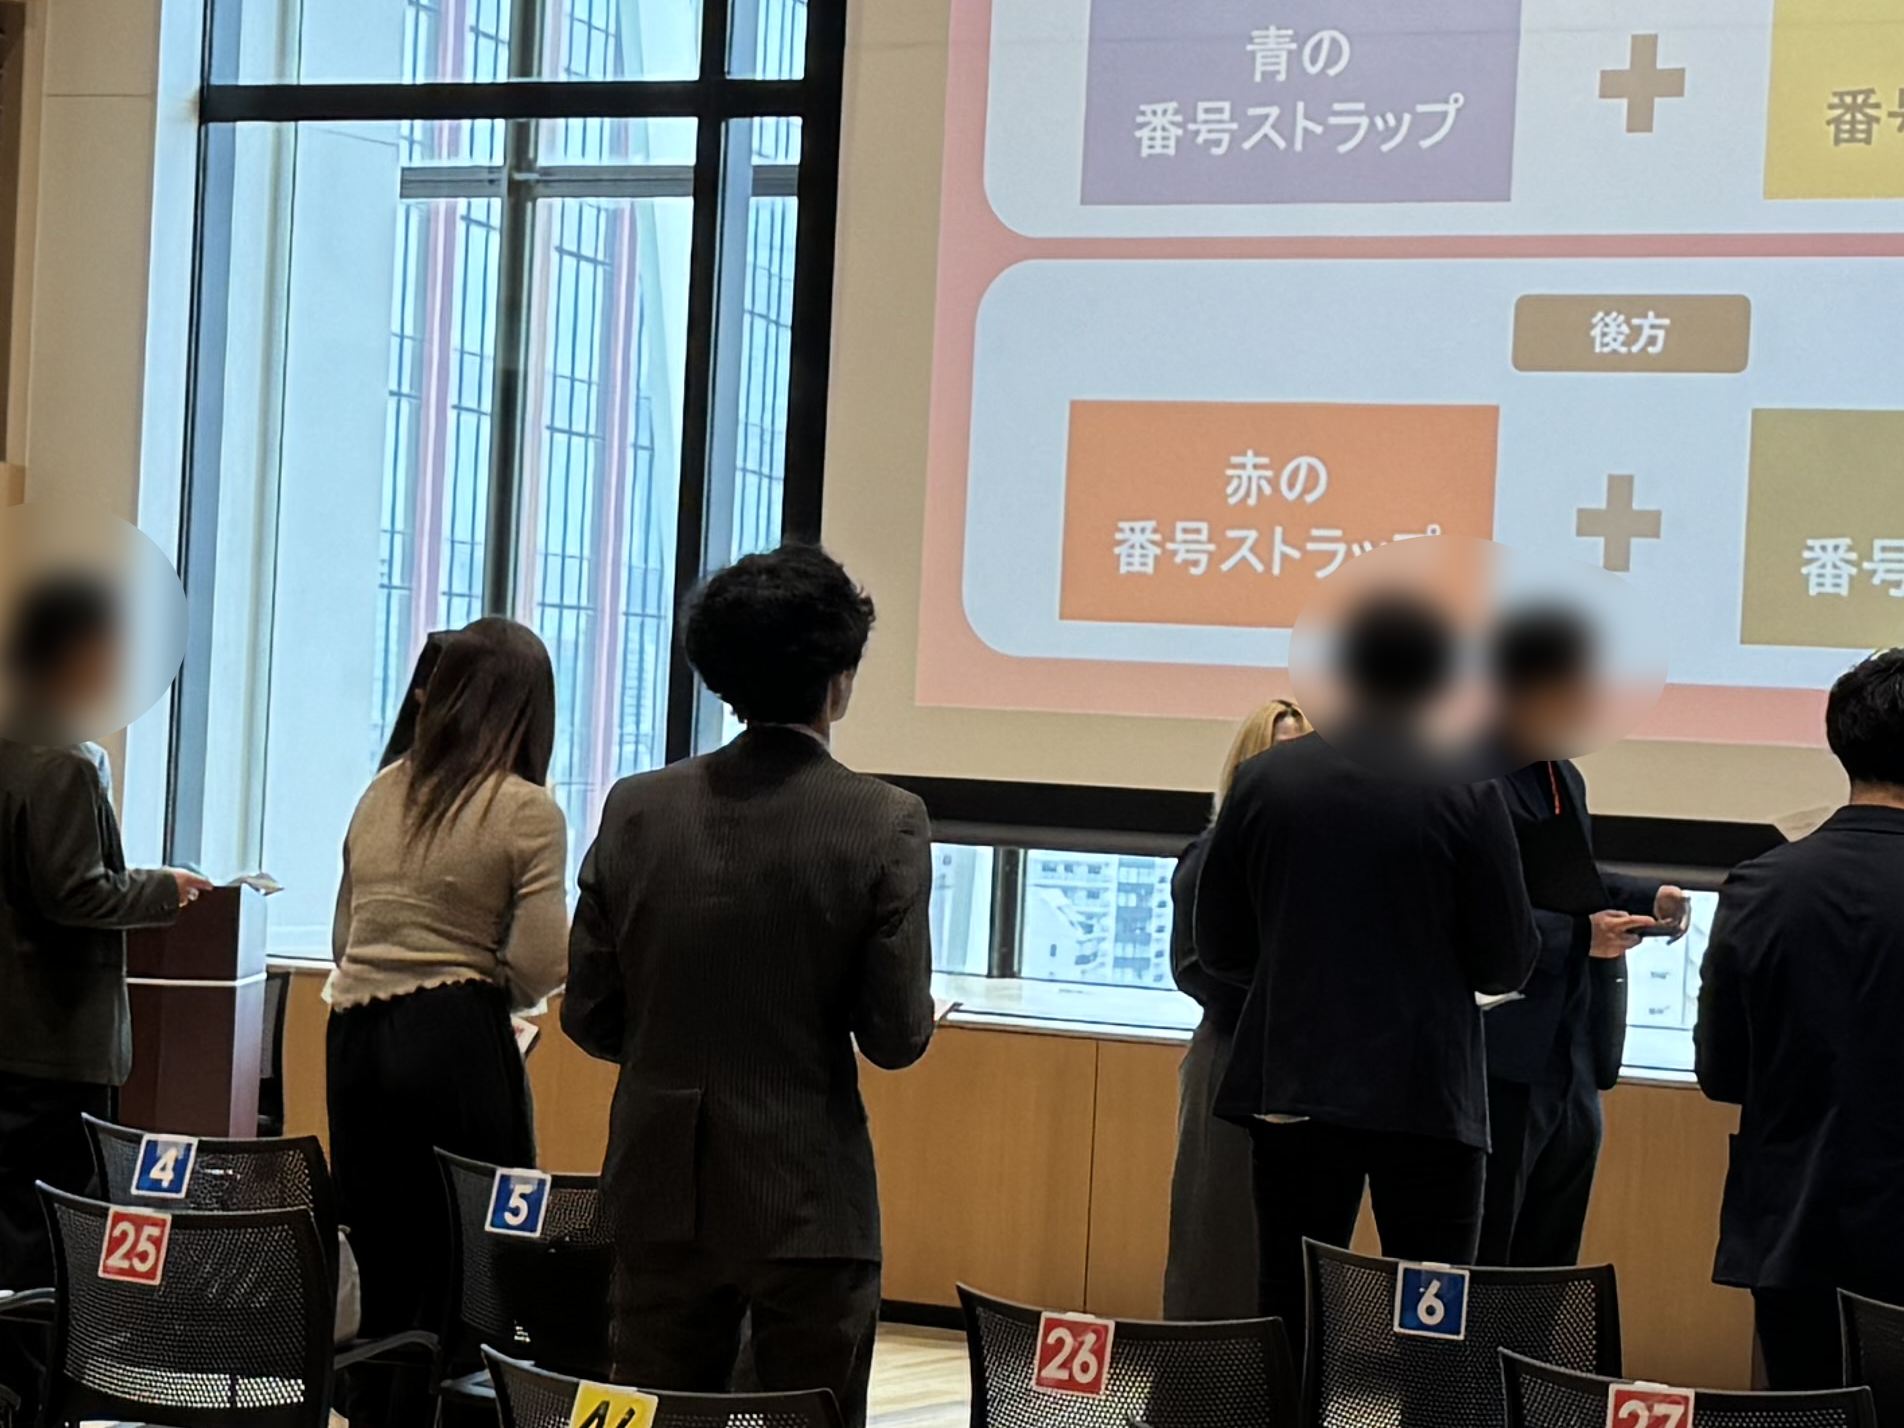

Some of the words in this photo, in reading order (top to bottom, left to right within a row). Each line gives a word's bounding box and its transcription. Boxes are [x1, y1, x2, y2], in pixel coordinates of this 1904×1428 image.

[1245, 24, 1351, 83] 青の
[1132, 91, 1465, 158] 番号ストラップ
[1589, 310, 1672, 356] 後方
[1223, 449, 1329, 507] 赤の
[149, 1148, 181, 1187] 4
[502, 1183, 532, 1227] 5
[104, 1221, 162, 1273] 25
[1416, 1279, 1446, 1327] 6
[1041, 1329, 1100, 1383] 26
